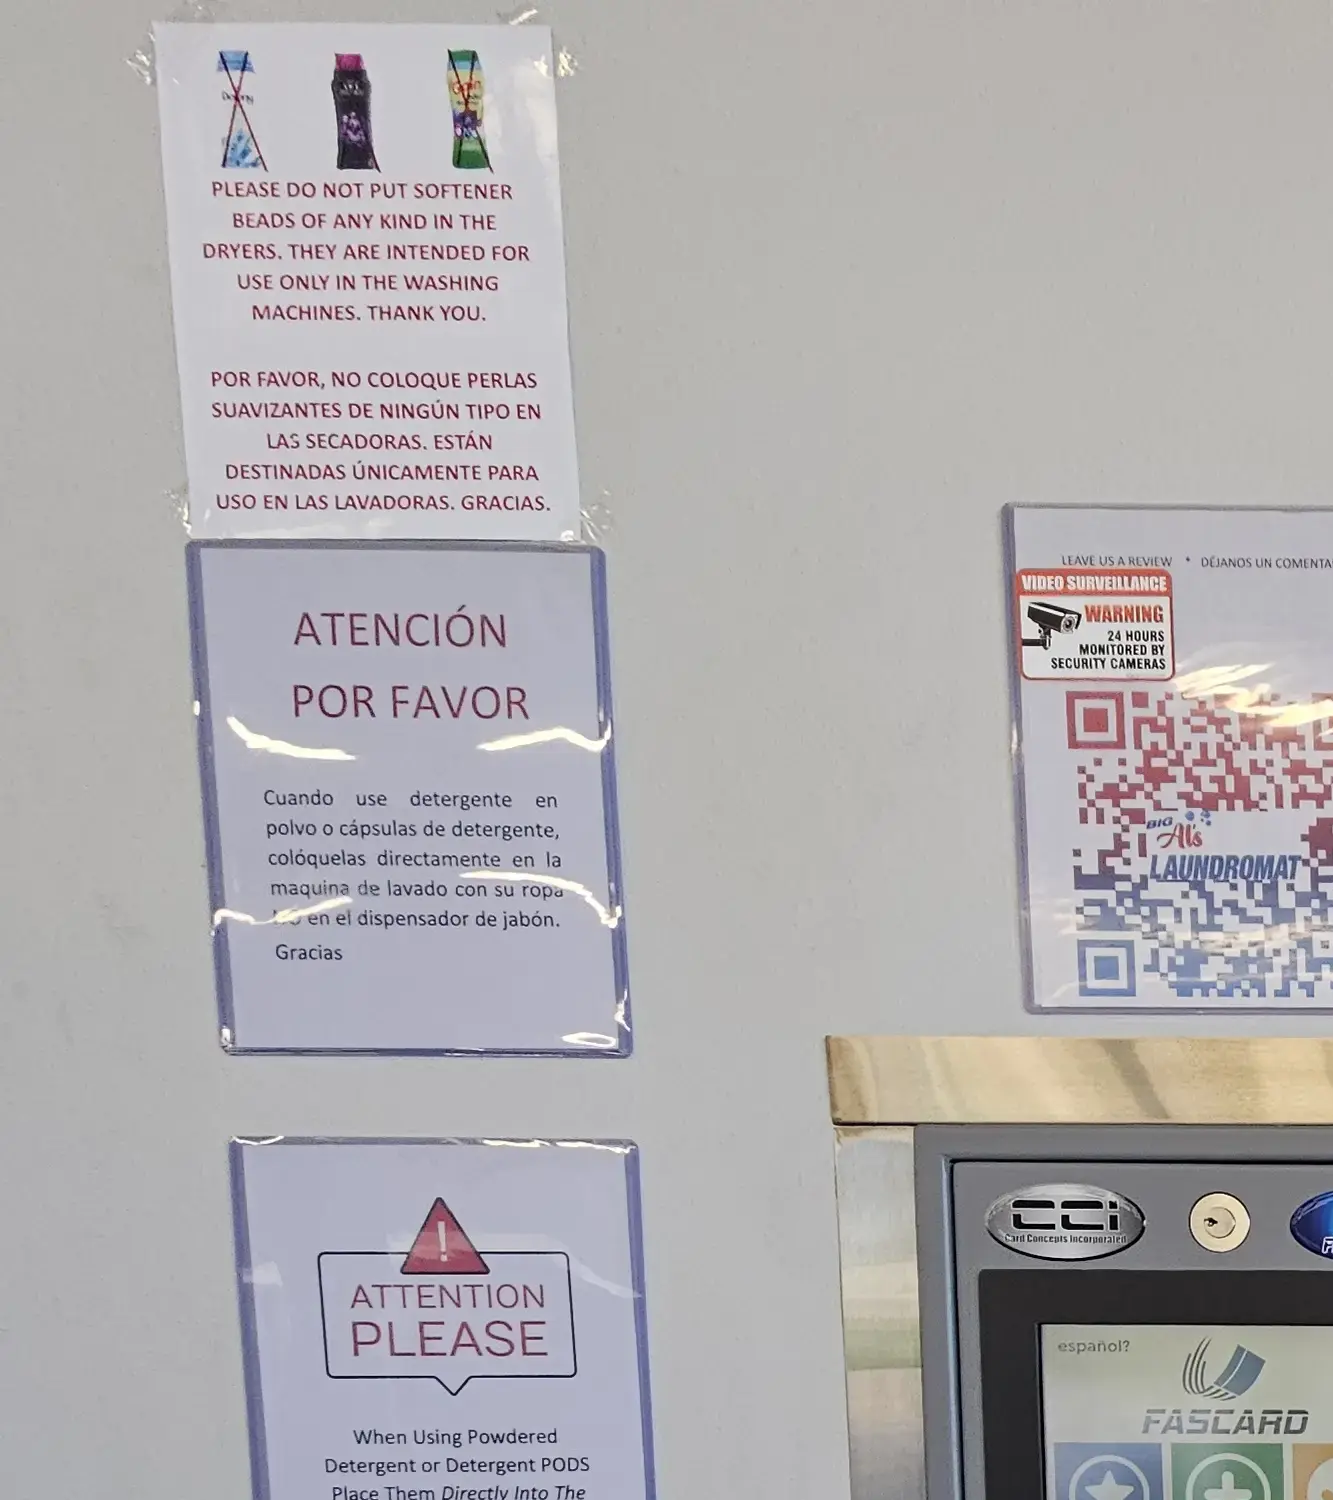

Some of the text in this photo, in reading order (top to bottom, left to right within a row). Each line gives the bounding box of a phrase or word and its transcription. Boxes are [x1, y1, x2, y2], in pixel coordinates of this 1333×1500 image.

[211, 181, 513, 200] PLEASE DO NOT PUT SOFTENER
[232, 212, 496, 230] BEADS OF ANY KIND IN THE
[203, 243, 530, 261] DRYERS. THEY ARE INTENDED FOR
[211, 371, 537, 391] POR FAVOR, NO COLOQUE PERLAS
[1061, 555, 1172, 567] LEAVE US A REVIEW
[1200, 555, 1252, 568] DÉJANOS
[1255, 558, 1272, 568] UN
[1021, 574, 1167, 592] VIDEO SURVEILLANCE
[1084, 604, 1164, 623] WARNING
[293, 604, 508, 648] ATENCIÓN
[1107, 630, 1165, 642] 24 HOURS
[1079, 643, 1165, 656] MONITORED BY
[1051, 657, 1166, 670] SECURITY CAMERAS
[292, 684, 529, 719] POR FAVOR
[263, 788, 557, 811] Cuando use detergente en
[266, 818, 559, 841] polvo o cápsulas de detergente,
[1146, 816, 1173, 829] BIG
[1149, 854, 1302, 881] LAUNDROMAT
[1004, 1232, 1127, 1244] Card Concepts Incorporated
[350, 1283, 544, 1309] ATTENTION
[351, 1319, 548, 1357] PLEASE
[1057, 1339, 1130, 1355] español?
[1142, 1409, 1309, 1435] FASCARD
[352, 1428, 557, 1448] When Using Powdered
[324, 1456, 590, 1477] Detergent or Detergent PODS
